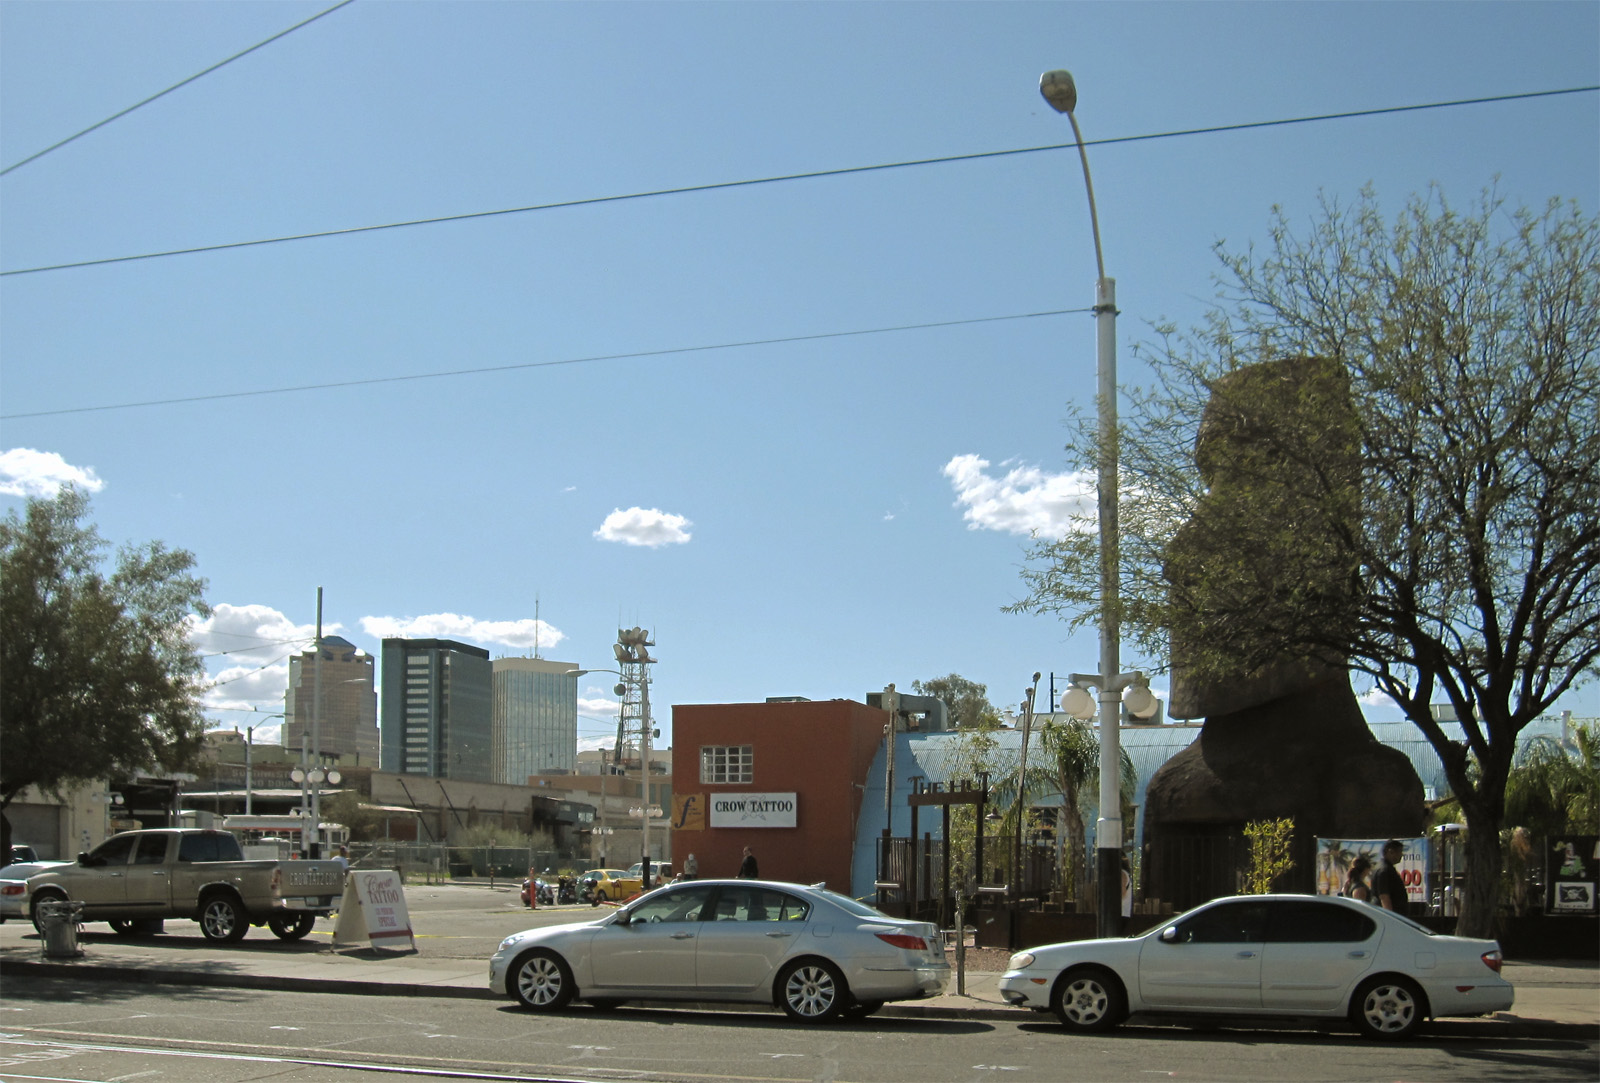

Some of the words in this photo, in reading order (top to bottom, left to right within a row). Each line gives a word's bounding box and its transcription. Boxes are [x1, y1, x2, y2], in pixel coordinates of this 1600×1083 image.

[907, 776, 944, 794] THE
[948, 772, 991, 793] HUT
[715, 801, 747, 812] CROW
[751, 800, 793, 812] TATTOO
[367, 889, 400, 905] TATTOO
